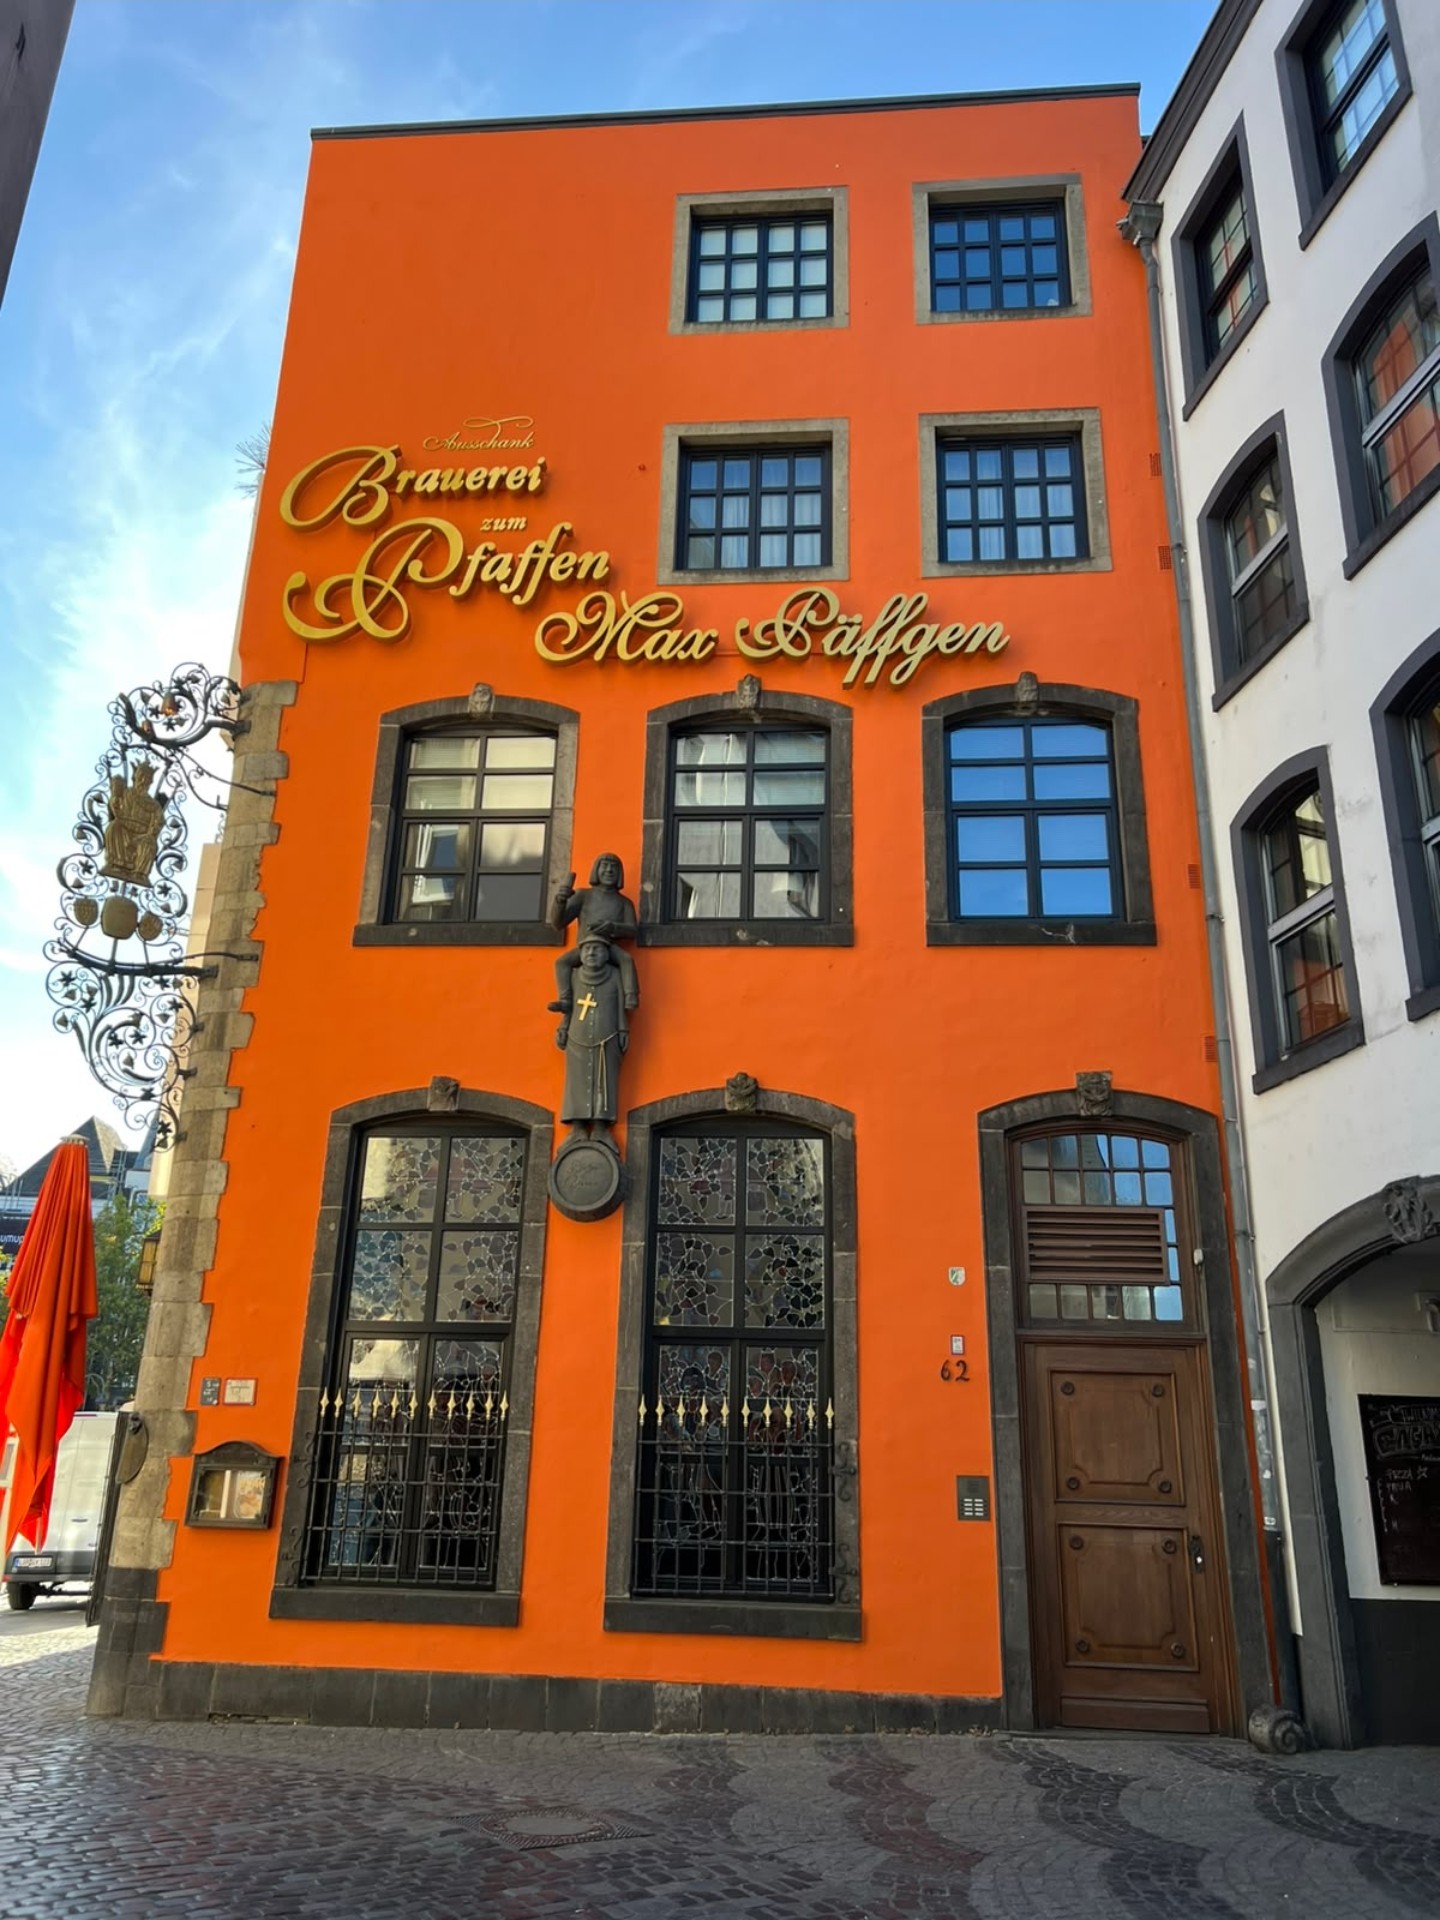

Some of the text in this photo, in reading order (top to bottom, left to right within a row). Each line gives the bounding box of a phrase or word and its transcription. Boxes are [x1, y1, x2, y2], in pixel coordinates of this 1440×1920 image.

[422, 416, 535, 450] Ausschank
[279, 445, 547, 528] Brauerei
[480, 515, 528, 532] zum
[282, 517, 611, 641] Pfaffen
[534, 585, 1011, 690] Max Päffgen
[940, 1359, 970, 1382] 62
